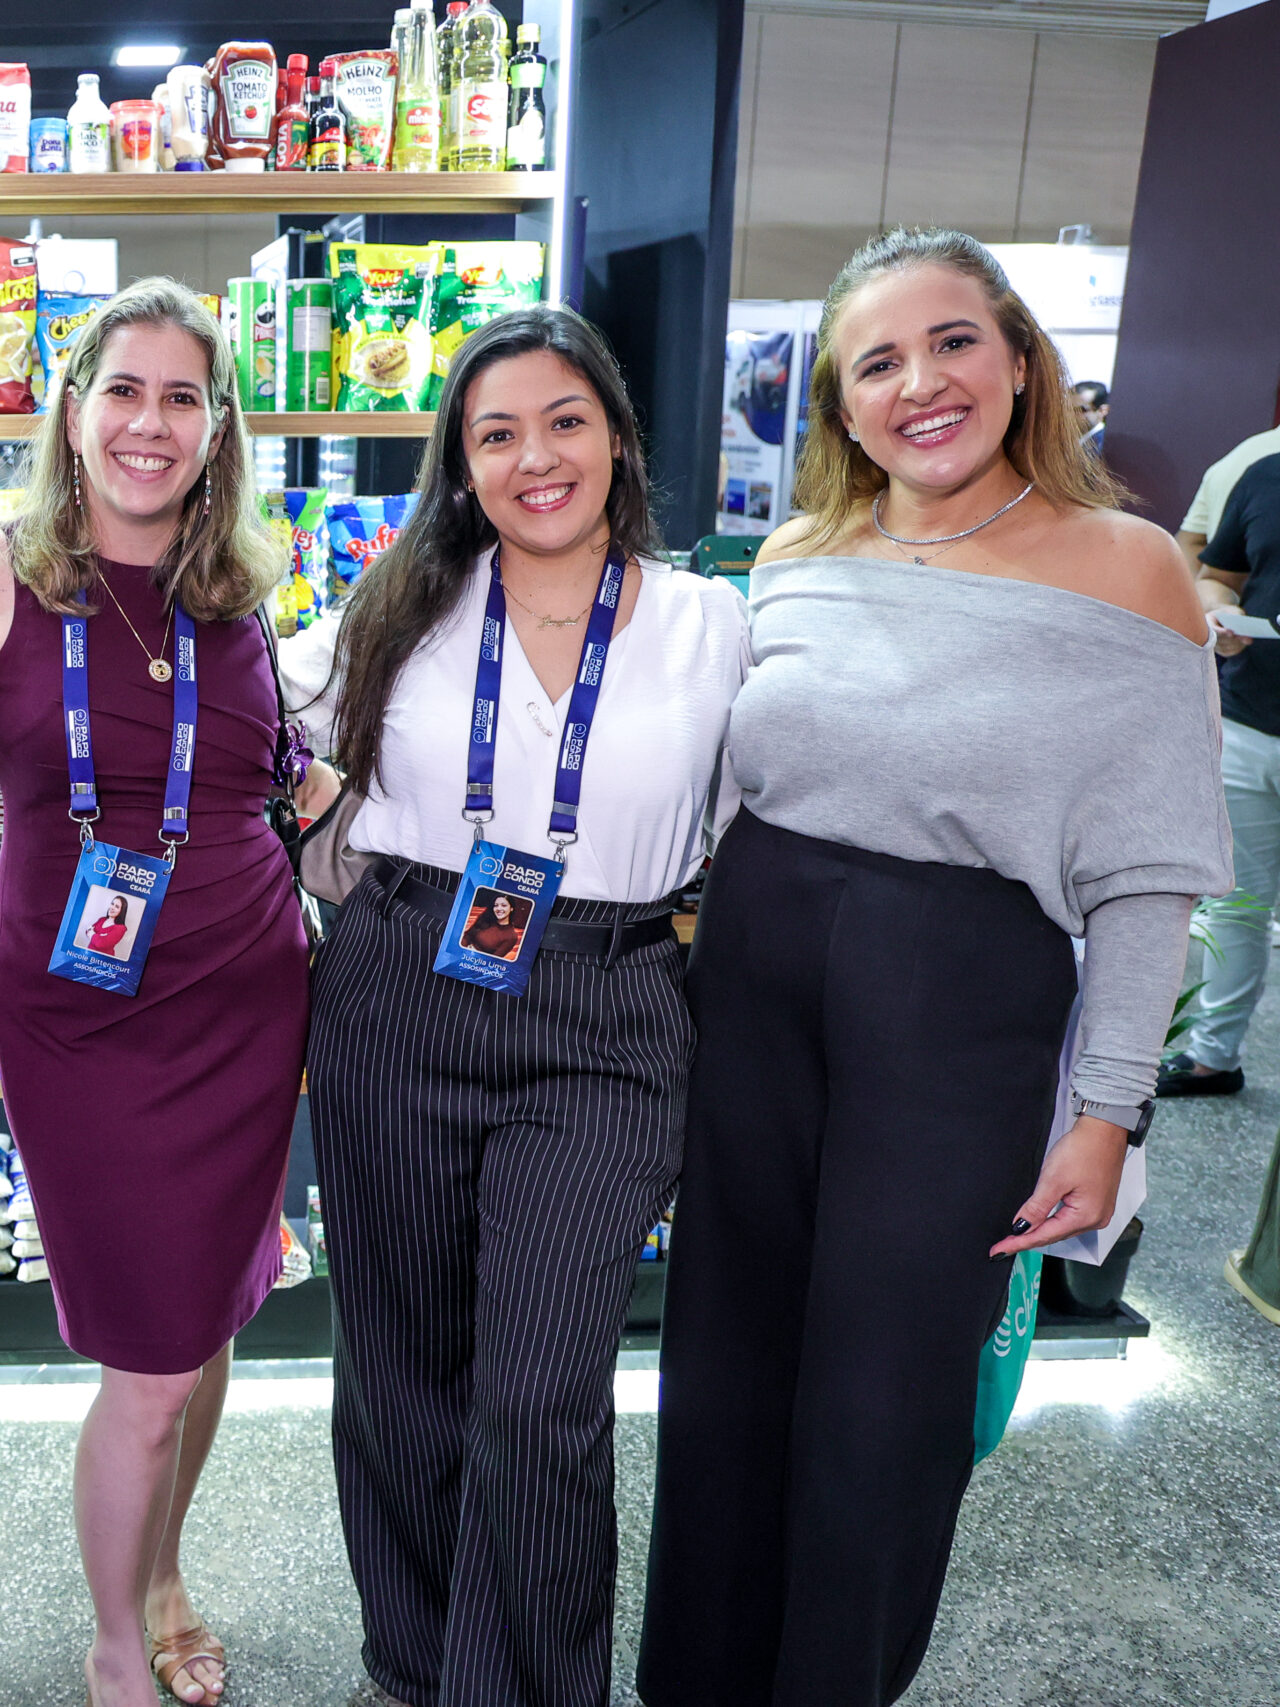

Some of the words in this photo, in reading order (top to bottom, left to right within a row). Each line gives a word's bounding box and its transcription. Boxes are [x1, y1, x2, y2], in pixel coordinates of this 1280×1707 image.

[236, 67, 263, 77] HEINZ
[346, 64, 382, 80] HEINZ
[232, 82, 267, 92] TOMATO
[50, 309, 97, 341] Chee
[345, 523, 404, 561] Ruff
[483, 617, 492, 644] PAPO
[77, 638, 85, 668] PAPO
[590, 658, 602, 686] PAPO
[475, 698, 484, 727] PAPO
[481, 699, 489, 727] CONDO
[75, 726, 83, 758] CONDO
[80, 725, 90, 758] PAPO
[176, 722, 184, 754] PAPO
[181, 723, 189, 755] CONDO
[567, 737, 577, 770] CONDO
[572, 738, 584, 770] PAPO
[116, 872, 154, 888] CONDO
[118, 862, 157, 881] PAPO
[503, 871, 543, 888] CONDO
[505, 863, 546, 881] PAPO
[130, 884, 151, 895] CEARÁ
[517, 885, 540, 895] CEARÁ
[67, 950, 89, 962] Nicole
[90, 957, 130, 974] Bittencourt
[488, 961, 507, 971] Lima
